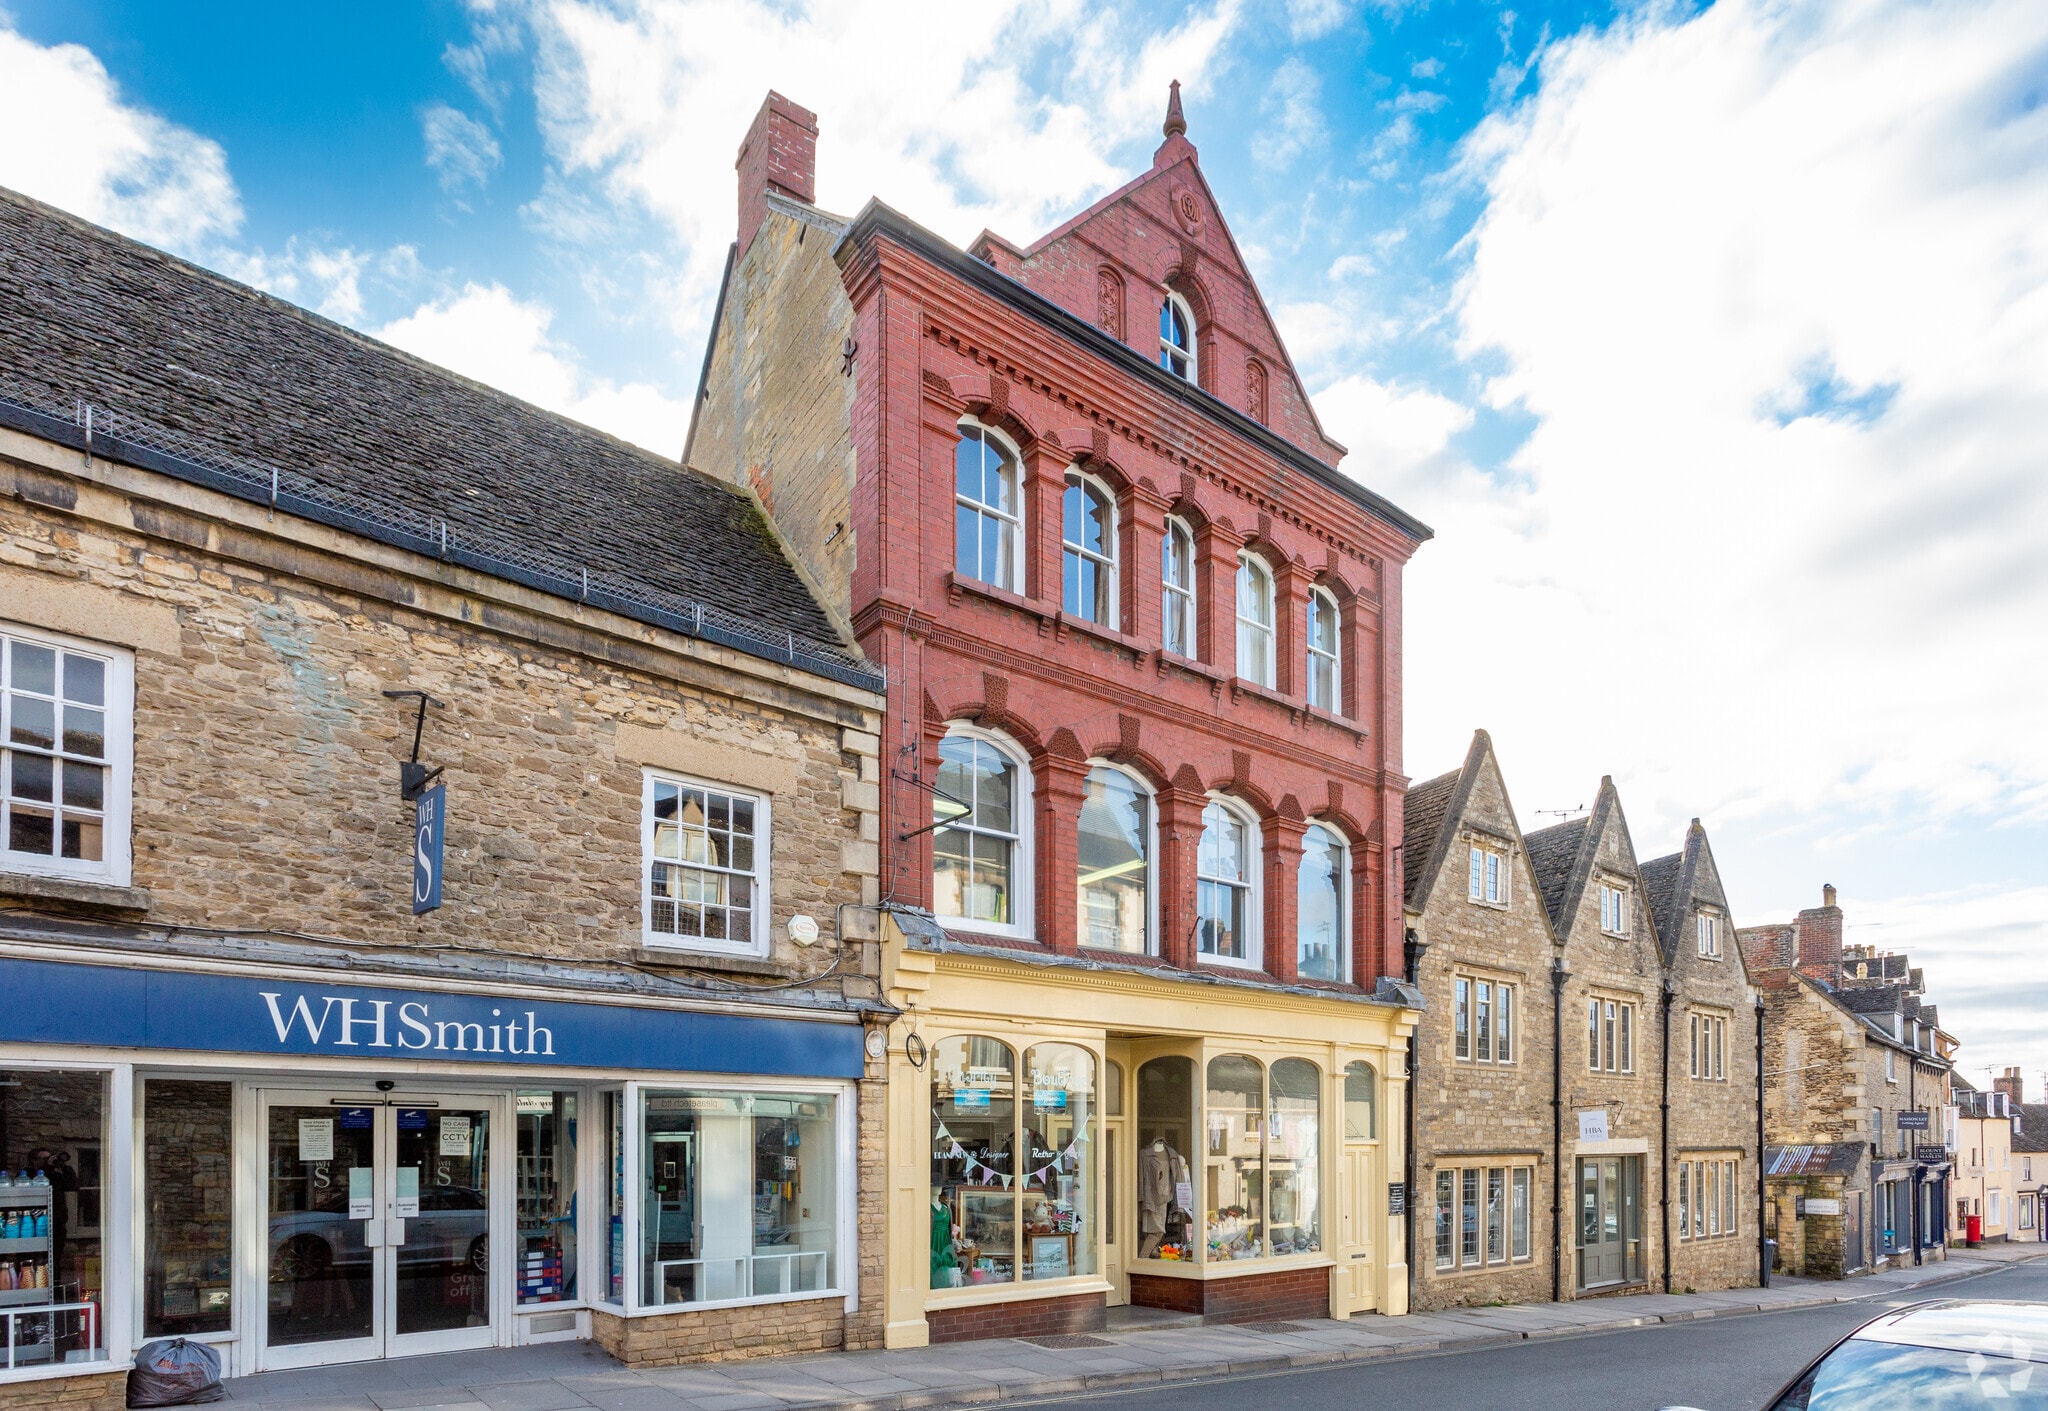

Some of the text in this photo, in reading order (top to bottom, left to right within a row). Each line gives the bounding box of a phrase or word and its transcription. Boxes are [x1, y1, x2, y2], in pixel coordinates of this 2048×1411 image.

[418, 797, 434, 825] WH
[416, 823, 432, 903] S
[259, 992, 556, 1055] WHSmith
[441, 1133, 469, 1141] CCTV
[980, 1147, 1009, 1162] Designer
[1031, 1147, 1055, 1159] Retro
[313, 1167, 331, 1188] S
[436, 1166, 452, 1187] S
